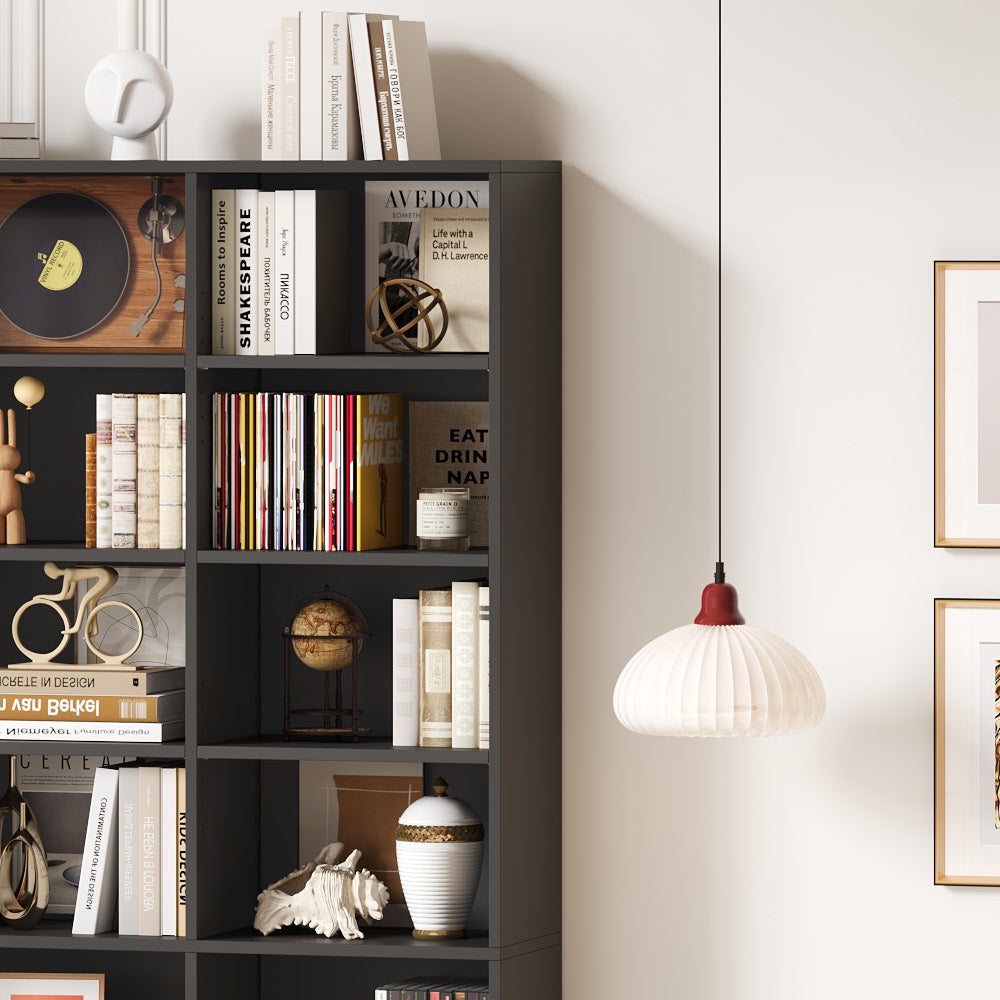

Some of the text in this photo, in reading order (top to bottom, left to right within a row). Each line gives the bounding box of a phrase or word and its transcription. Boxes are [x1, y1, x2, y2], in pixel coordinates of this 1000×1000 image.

[267, 84, 275, 118] Маленькие
[328, 75, 342, 150] Братья Карамазовы
[389, 68, 405, 140] ГОВОРИ КАК БОГ
[384, 190, 480, 208] AVEDON
[217, 201, 227, 243] Inspire
[433, 229, 448, 238] Life
[449, 229, 467, 238] with
[217, 247, 226, 259] to
[432, 240, 467, 251] Capital L
[433, 251, 488, 260] D. H. Lawrence
[217, 263, 226, 305] Rooms
[240, 209, 251, 348] SHAKESPEARE
[280, 273, 289, 320] ПИКАССО
[368, 395, 391, 415] We
[363, 416, 399, 440] Want
[360, 440, 404, 466] MILES
[435, 450, 487, 463] DRIN
[20, 755, 126, 770] CEREA
